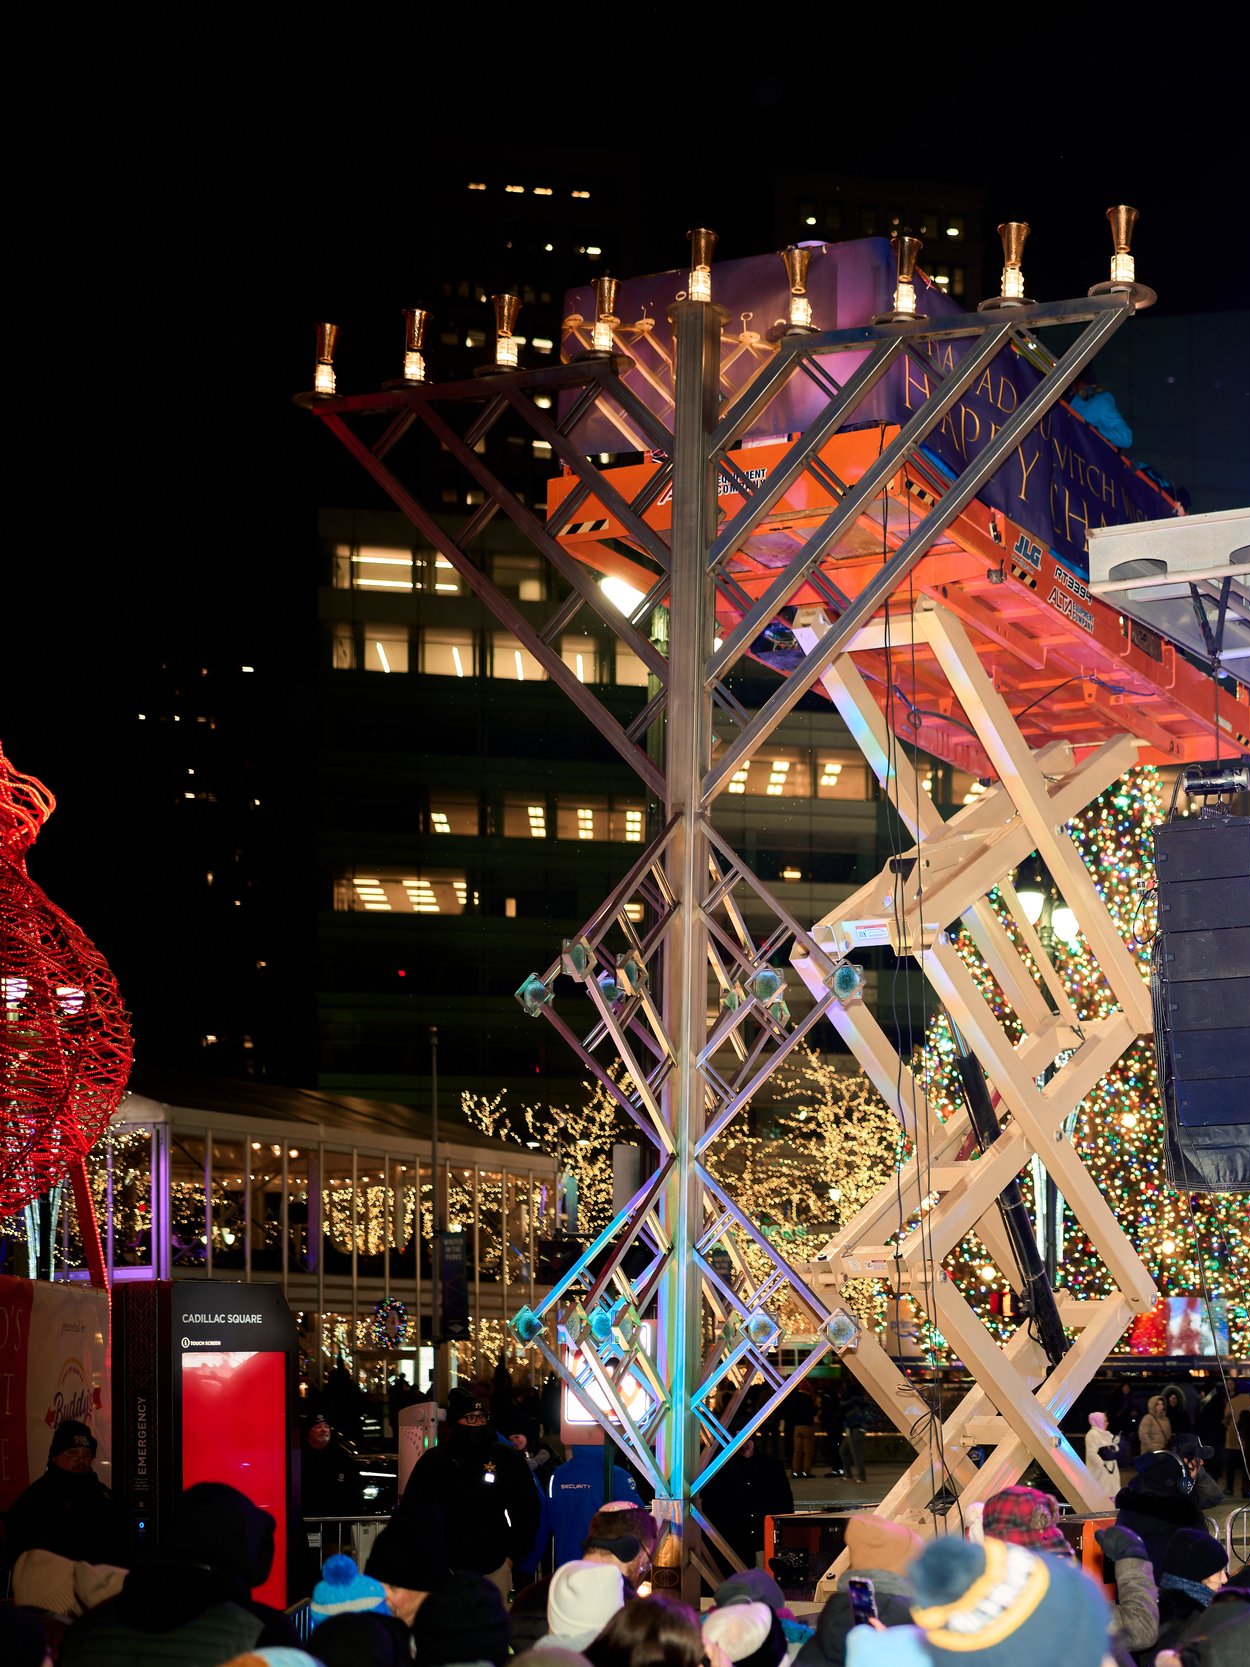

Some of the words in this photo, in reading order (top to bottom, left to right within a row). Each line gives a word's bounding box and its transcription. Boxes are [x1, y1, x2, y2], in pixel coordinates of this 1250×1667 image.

[1014, 533, 1042, 571] JLG
[1047, 586, 1074, 619] ALTA
[1054, 565, 1093, 605] RT3394
[1073, 611, 1094, 634] COMPANY
[181, 1314, 226, 1325] CADILLAC
[227, 1313, 263, 1324] SQUARE
[137, 1396, 148, 1475] EMERGENCY
